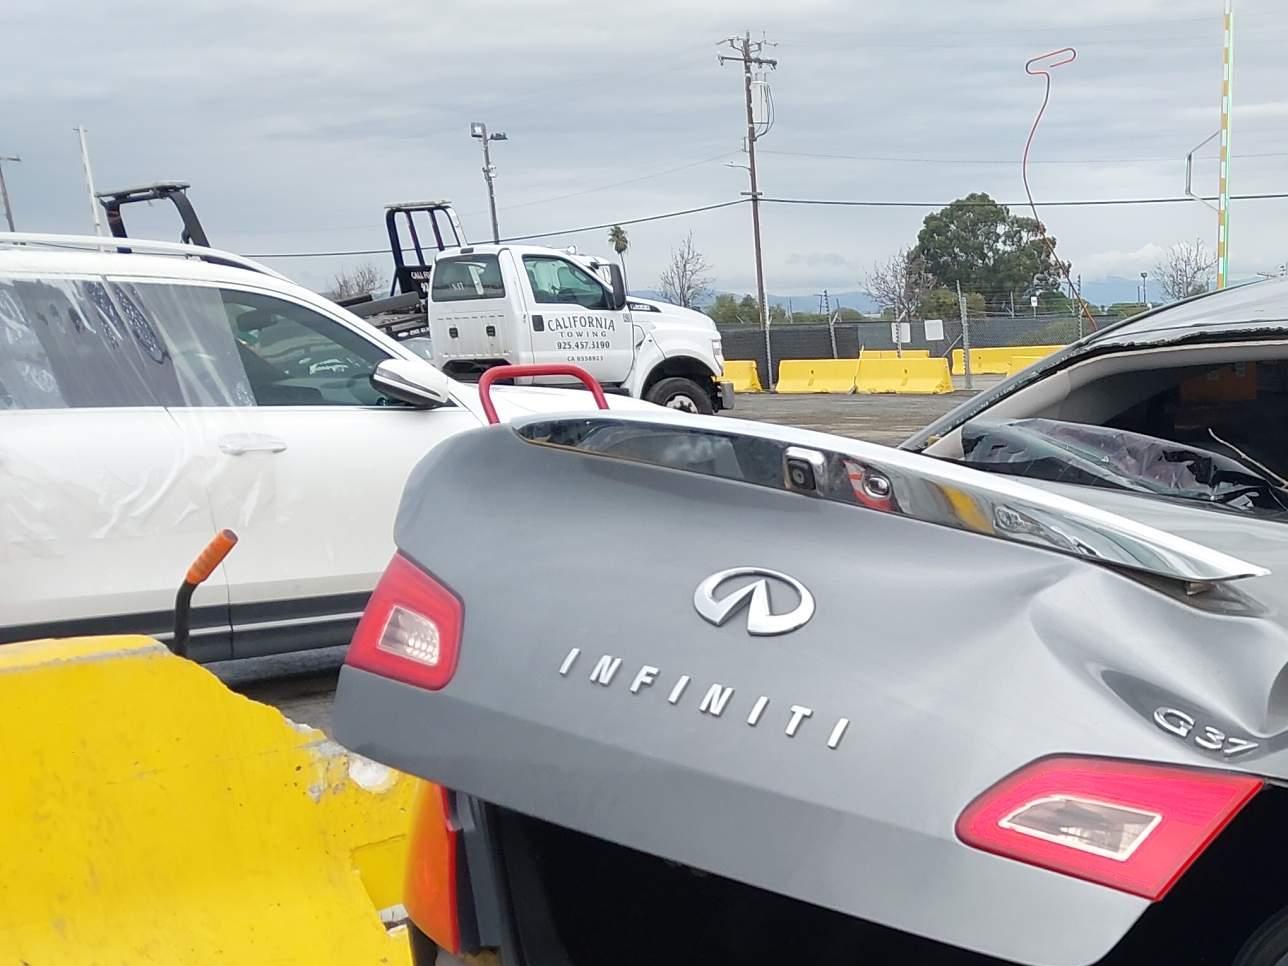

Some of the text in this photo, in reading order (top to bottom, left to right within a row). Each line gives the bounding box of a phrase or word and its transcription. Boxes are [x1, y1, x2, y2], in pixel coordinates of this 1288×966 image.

[547, 315, 615, 332] CALIFORNIA
[557, 341, 610, 349] 925.457.3190
[559, 647, 850, 749] INFINITI
[1153, 706, 1260, 757] G37
